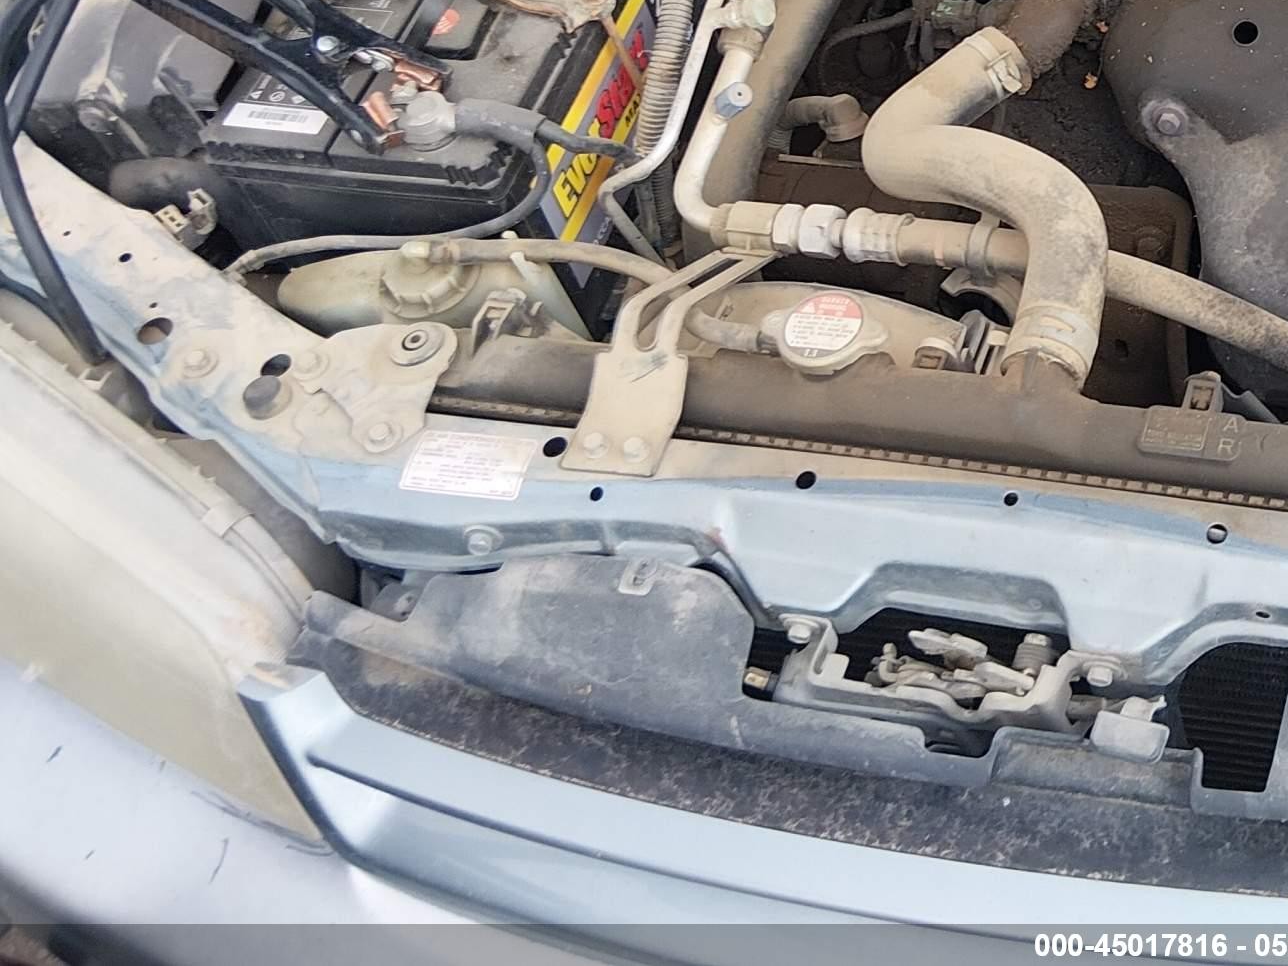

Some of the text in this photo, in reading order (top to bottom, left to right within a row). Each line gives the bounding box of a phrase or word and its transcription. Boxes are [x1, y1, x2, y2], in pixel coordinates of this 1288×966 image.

[553, 28, 648, 218] EveStat
[1222, 416, 1239, 433] A
[1217, 437, 1236, 455] R
